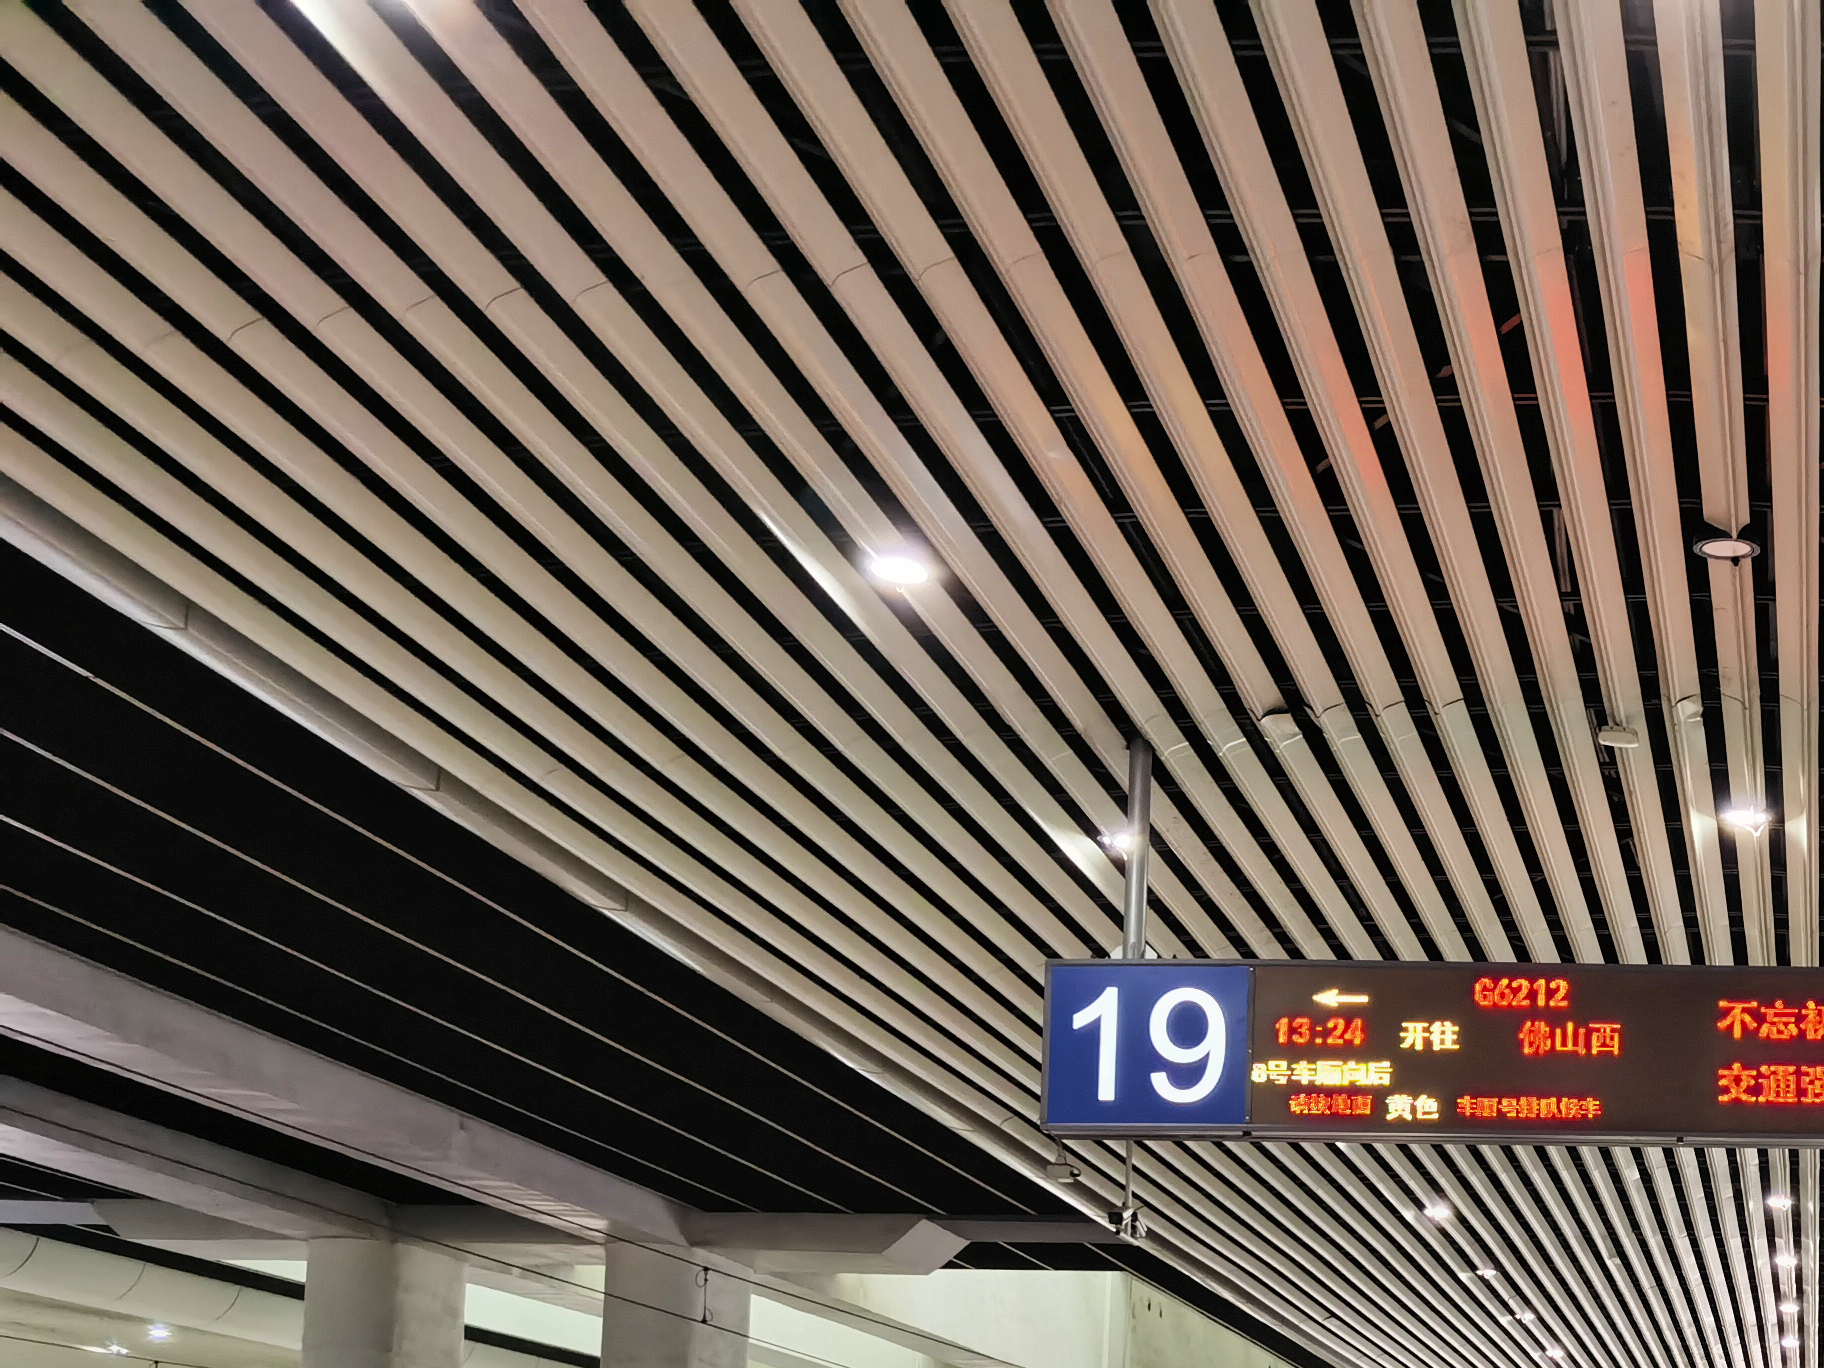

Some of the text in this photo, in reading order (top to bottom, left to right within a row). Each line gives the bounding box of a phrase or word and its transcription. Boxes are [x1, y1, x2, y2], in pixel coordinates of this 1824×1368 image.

[1474, 978, 1569, 1007] G6212
[1072, 987, 1227, 1103] 19
[1275, 1017, 1621, 1055] 13:24 开往 佛山西
[1385, 1094, 1440, 1121] 黄色
